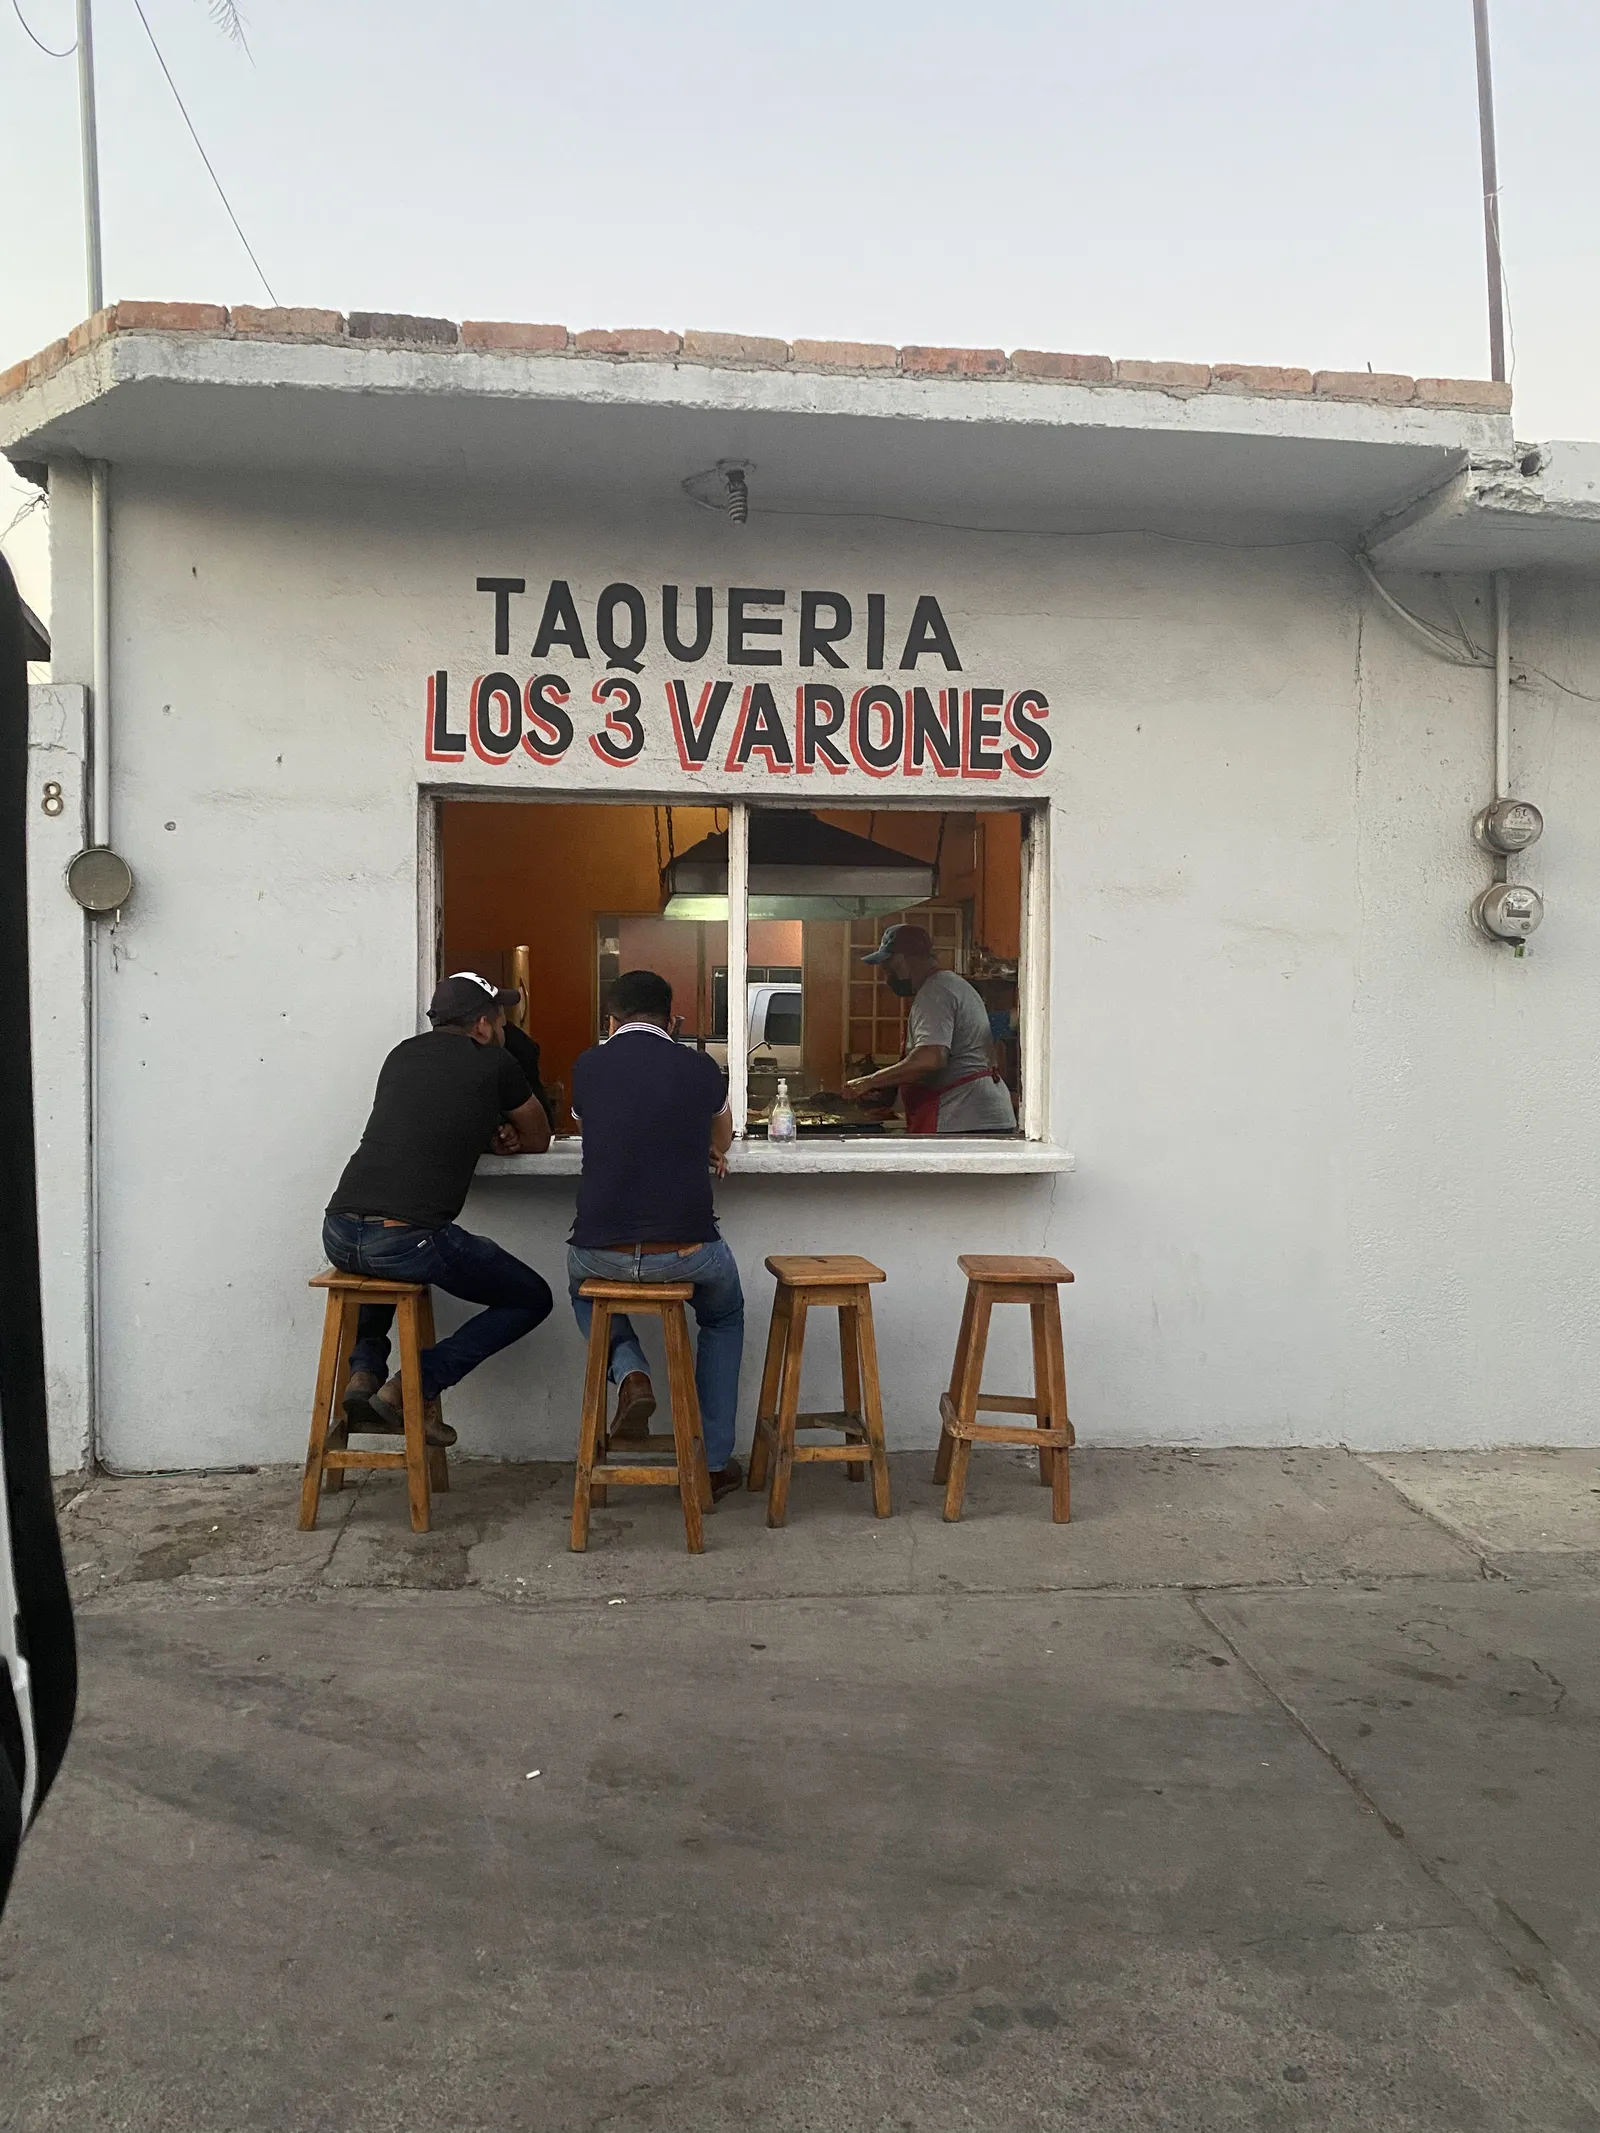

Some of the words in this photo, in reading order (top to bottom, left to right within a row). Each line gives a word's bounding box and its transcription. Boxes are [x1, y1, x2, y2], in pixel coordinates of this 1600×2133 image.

[476, 577, 963, 671] TAQUERIA
[425, 671, 574, 764] LOS
[589, 678, 645, 767] 3
[665, 680, 1053, 780] VARONES
[42, 781, 64, 816] 8
